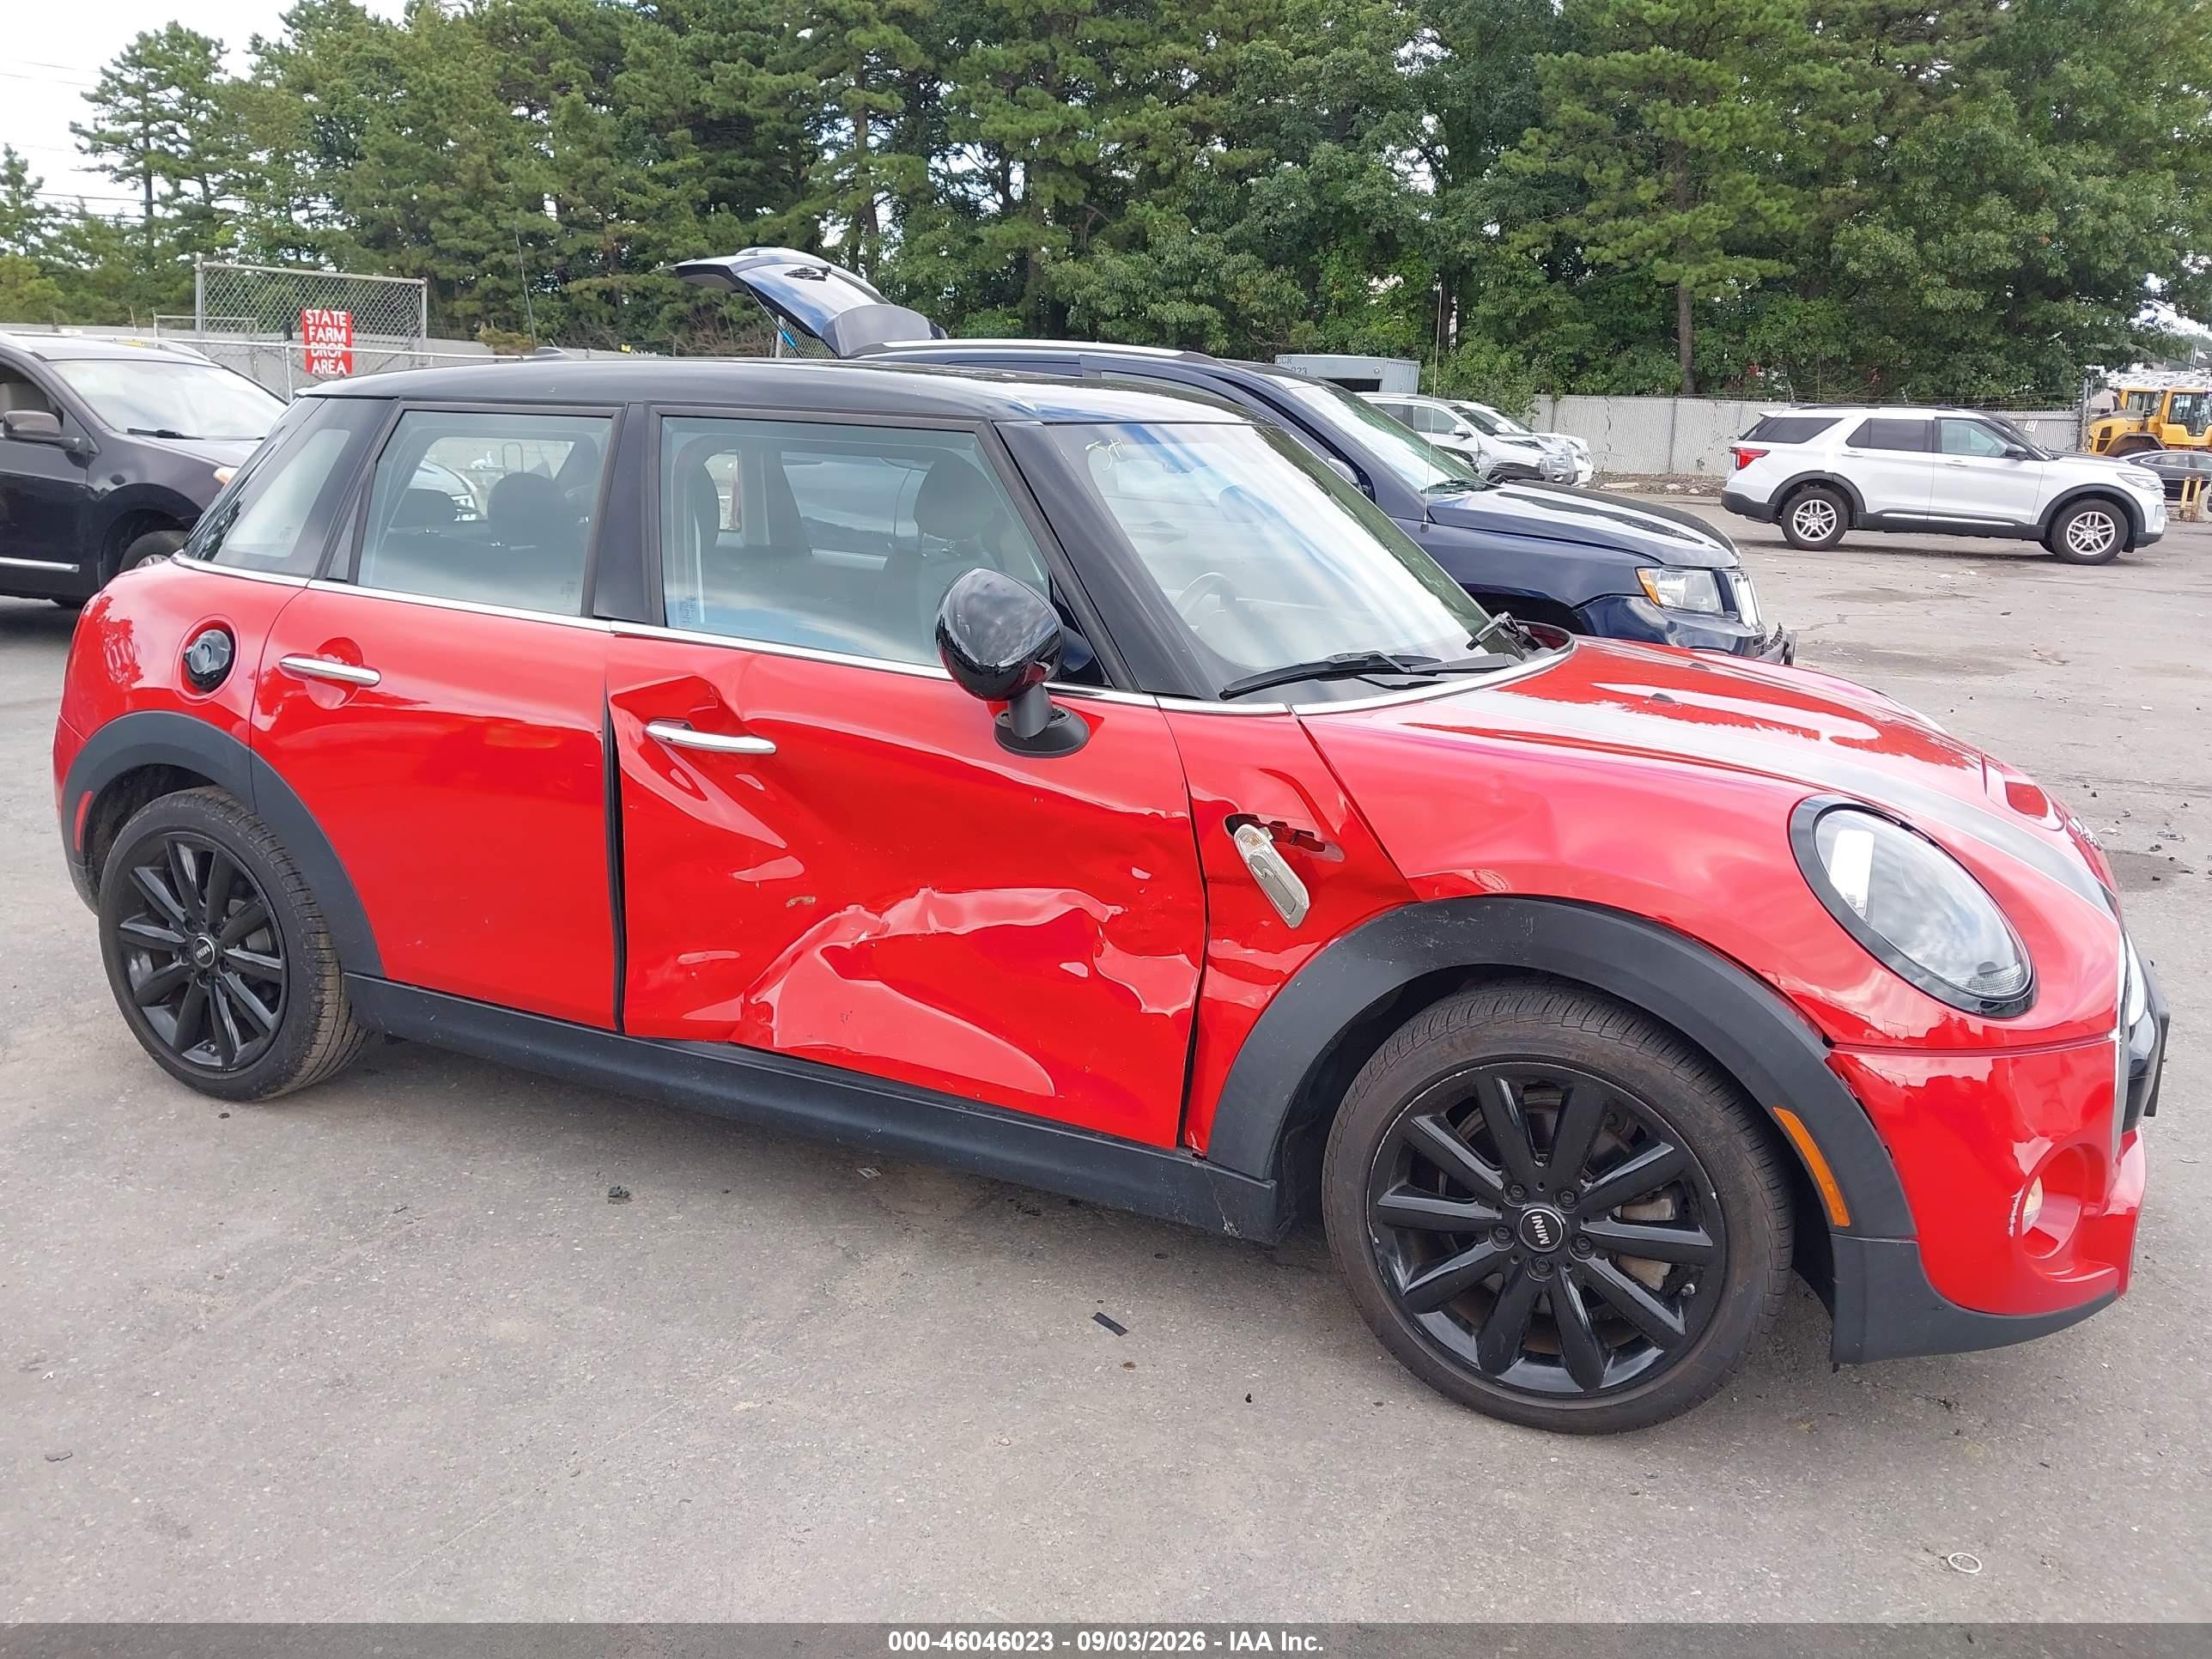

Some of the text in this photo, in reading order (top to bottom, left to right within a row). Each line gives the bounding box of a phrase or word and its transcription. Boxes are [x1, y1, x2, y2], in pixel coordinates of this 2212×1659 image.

[305, 309, 347, 326] STATE
[308, 325, 346, 343] FARM
[310, 342, 347, 358] DROP
[312, 359, 347, 374] AREA
[1531, 1215, 1551, 1245] MINI
